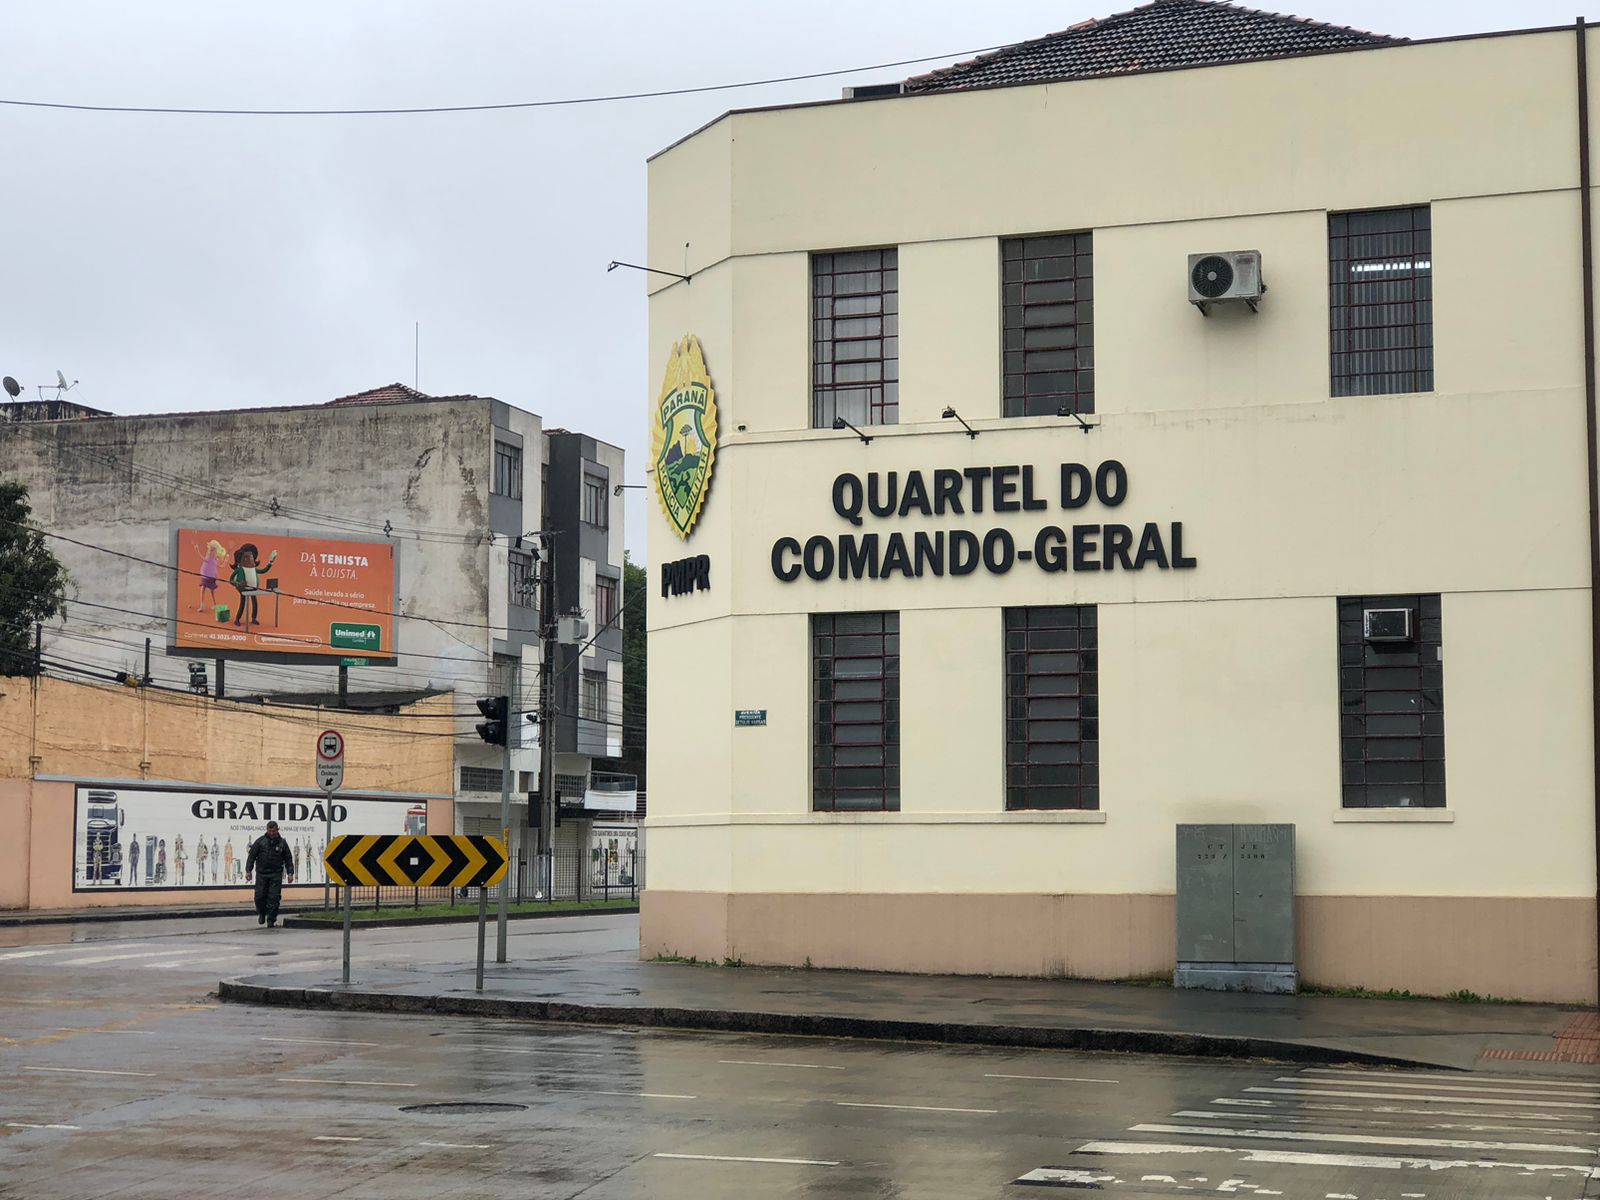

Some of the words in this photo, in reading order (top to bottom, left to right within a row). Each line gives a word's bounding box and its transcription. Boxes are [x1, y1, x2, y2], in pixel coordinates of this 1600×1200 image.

[663, 389, 705, 420] PARANÁ
[685, 451, 707, 515] MILITAR
[831, 463, 1048, 526] QUARTEL
[1060, 459, 1128, 509] DO
[300, 551, 316, 563] DA
[320, 553, 369, 567] TENISTA
[770, 521, 1198, 583] COMANDO-GERAL
[309, 563, 318, 577] À
[661, 554, 711, 598] PMPR
[303, 588, 323, 596] Saúde
[323, 589, 344, 598] levada
[349, 591, 365, 599] sério
[335, 629, 365, 638] Unimed
[191, 799, 348, 823] GRATIDÃO
